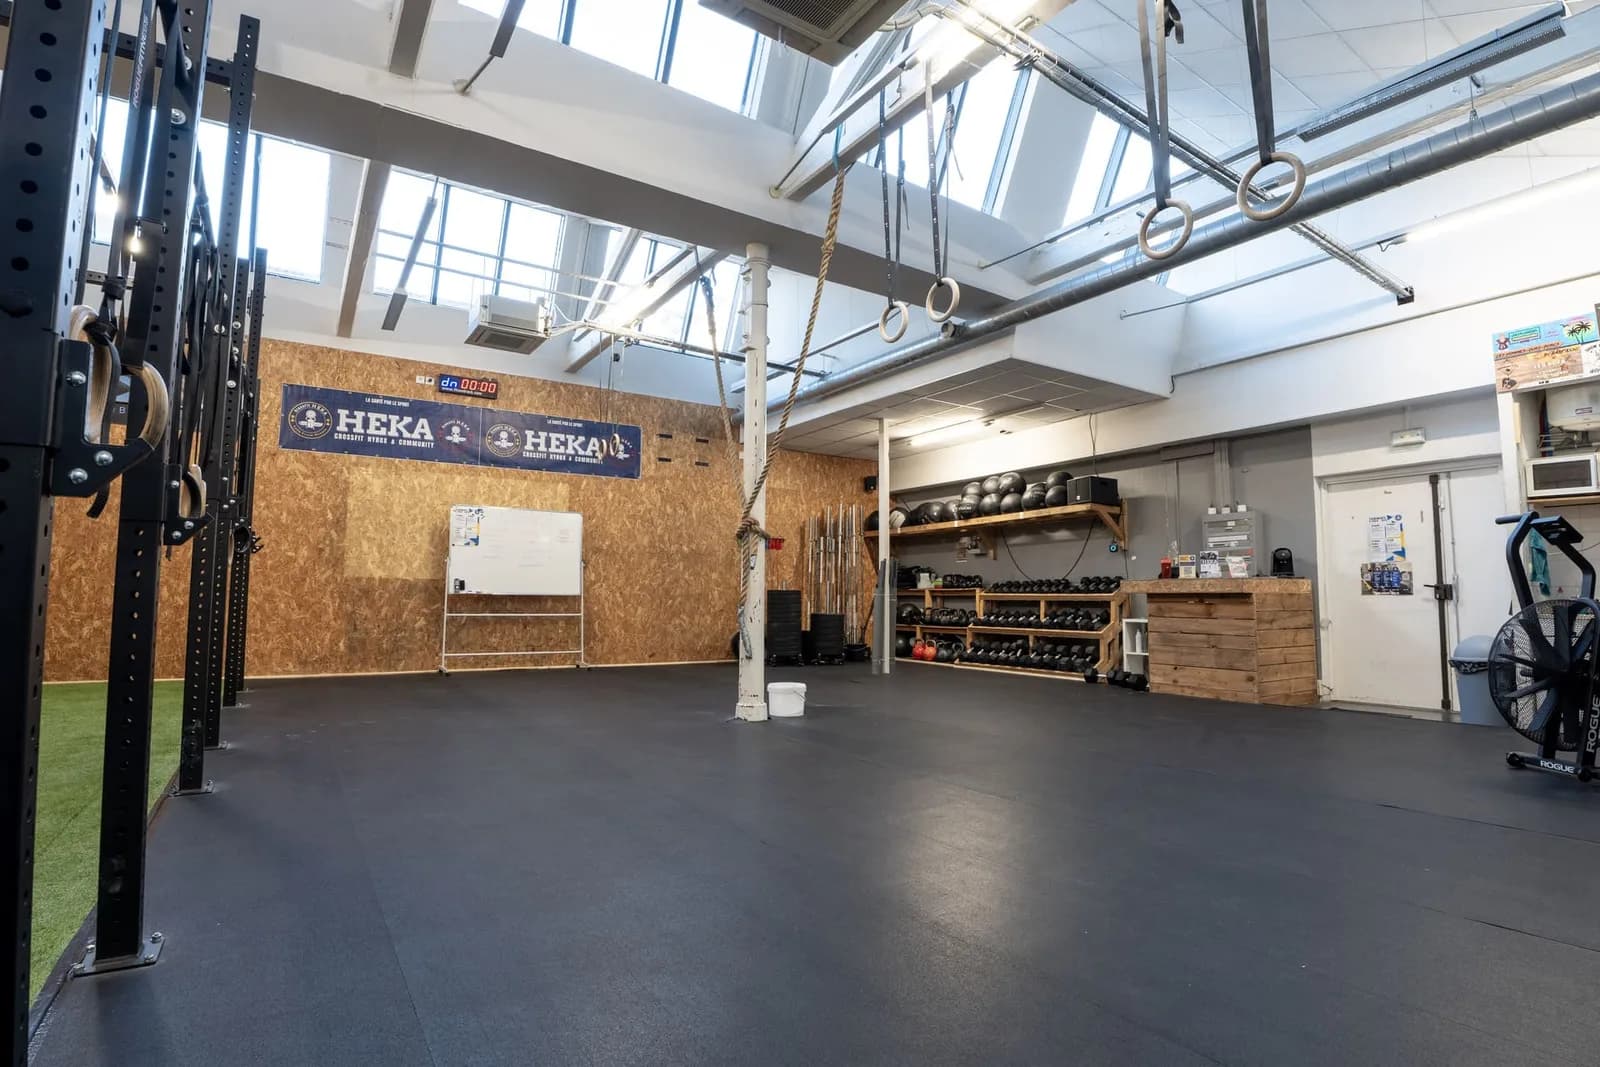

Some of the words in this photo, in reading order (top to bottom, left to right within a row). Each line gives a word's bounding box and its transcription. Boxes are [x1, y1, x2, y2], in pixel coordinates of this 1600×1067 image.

[461, 379, 496, 393] 00:00
[336, 408, 434, 440] HEKA
[334, 432, 364, 442] CROSSFIT
[398, 439, 435, 449] COMMUNITY
[524, 430, 601, 457] HEKA
[1586, 694, 1600, 752] ROGUE
[1540, 760, 1575, 774] ROGUE
